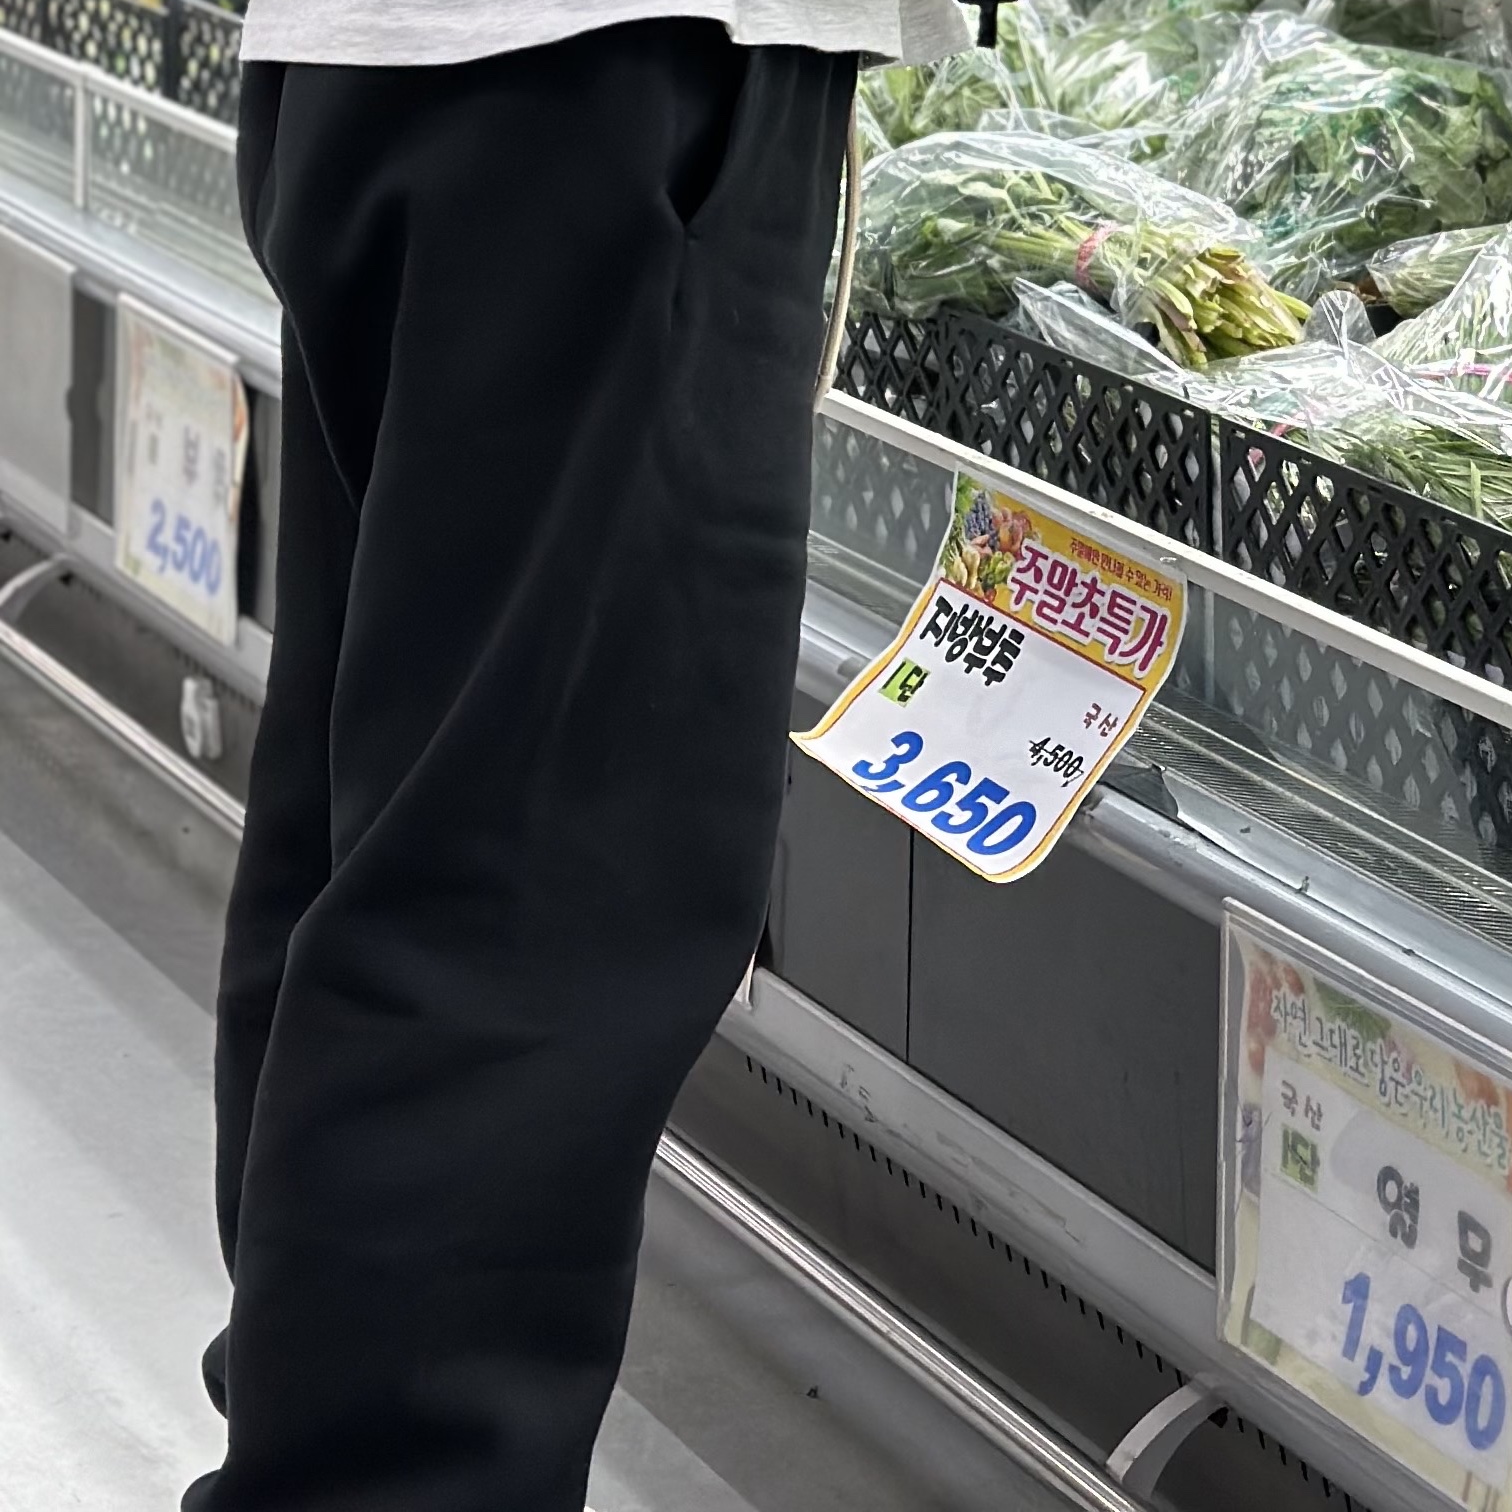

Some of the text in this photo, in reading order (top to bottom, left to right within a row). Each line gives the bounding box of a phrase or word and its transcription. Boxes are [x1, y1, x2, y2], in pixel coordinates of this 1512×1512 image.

[145, 497, 222, 596] 2,500
[1010, 544, 1168, 672] 주말초특가
[851, 730, 1037, 856] 3,650
[1272, 993, 1508, 1171] 자연 그대로 담은 우리 농산물
[1281, 1080, 1323, 1131] 국산
[1341, 1271, 1507, 1451] 1,950
